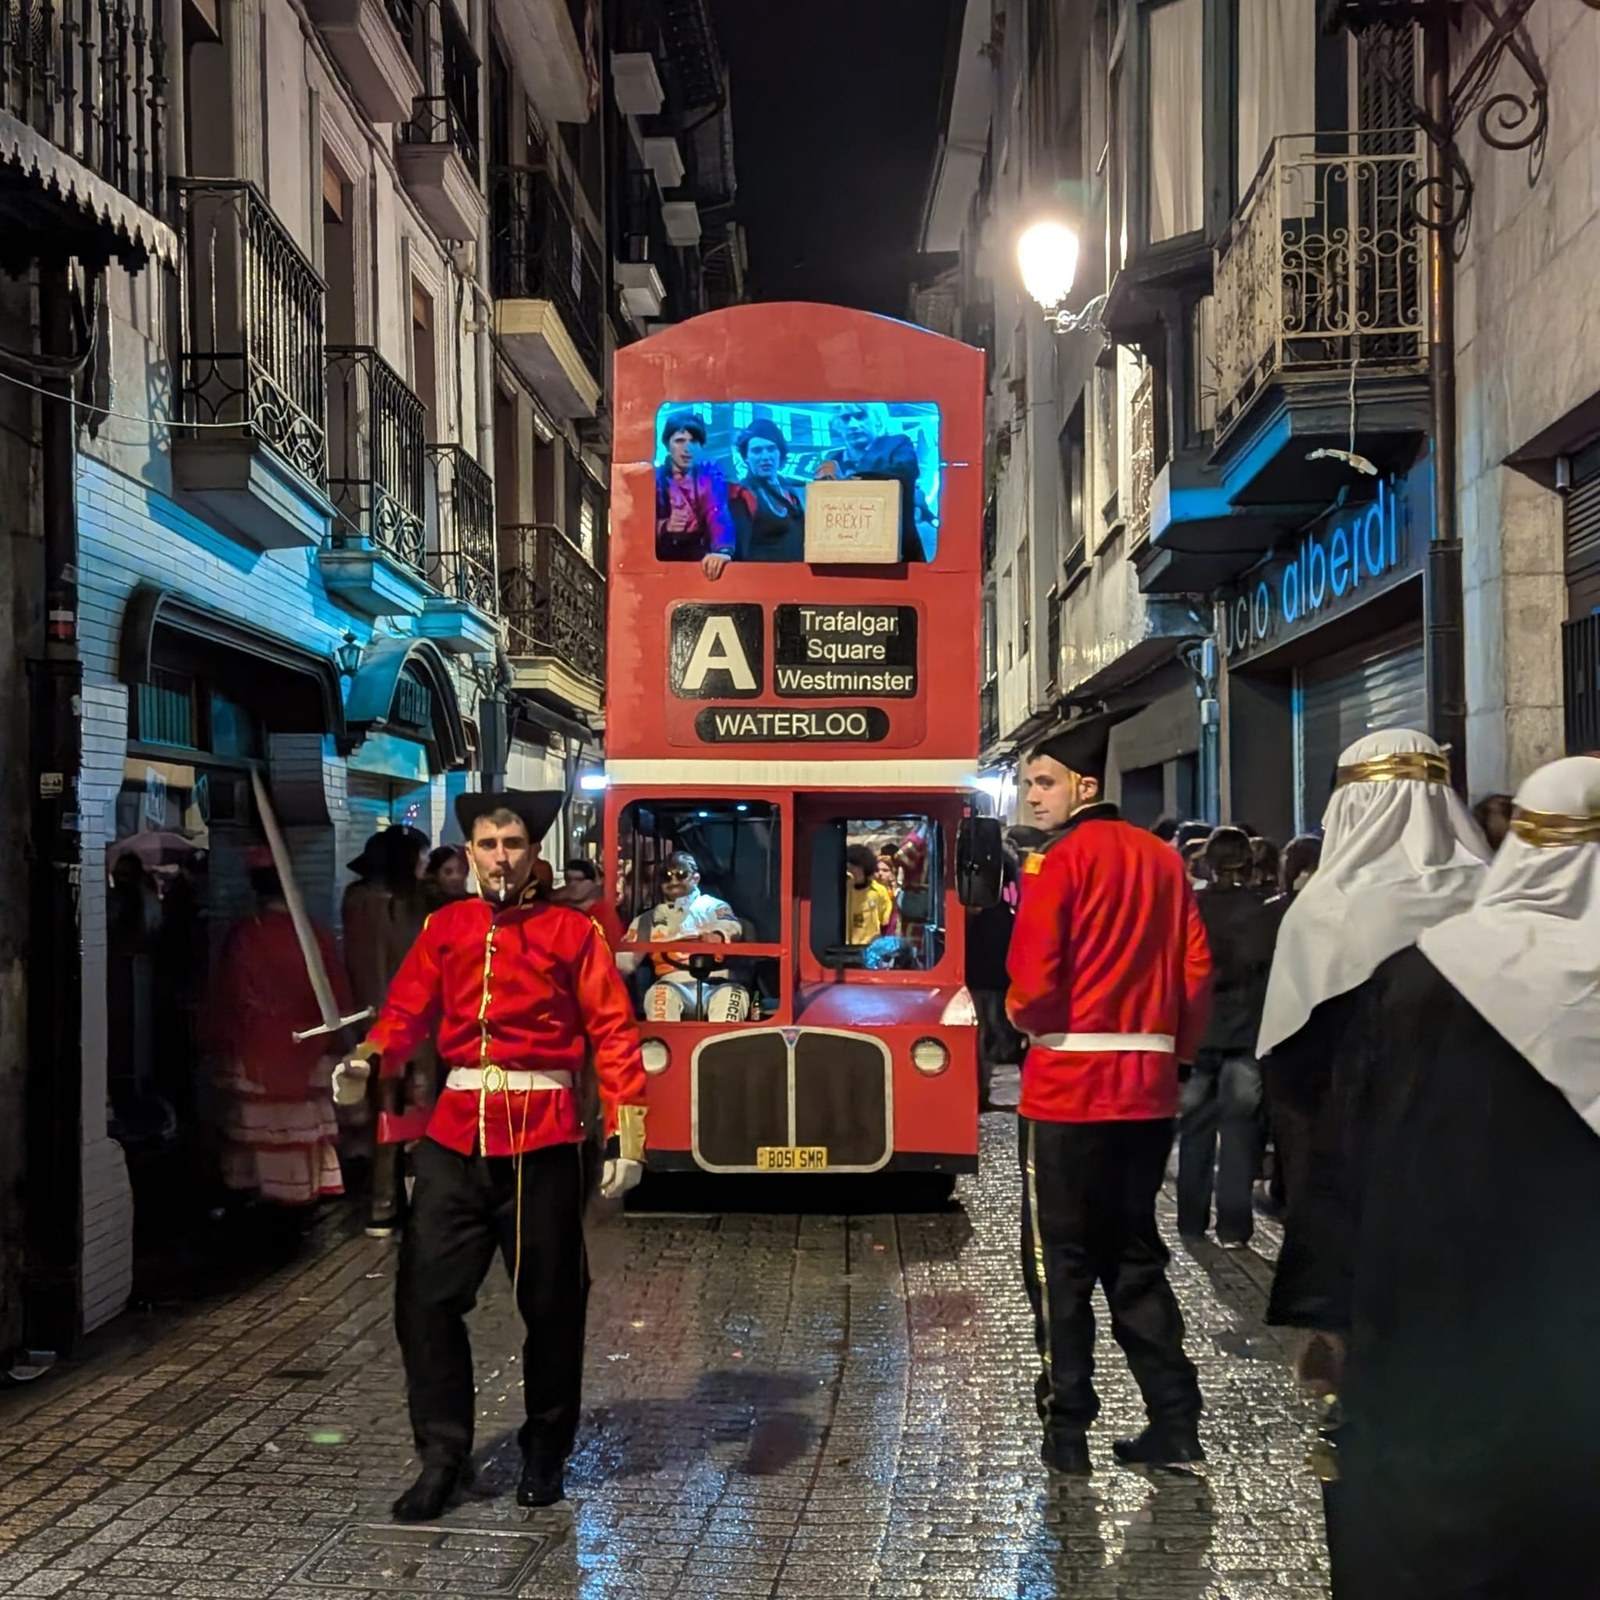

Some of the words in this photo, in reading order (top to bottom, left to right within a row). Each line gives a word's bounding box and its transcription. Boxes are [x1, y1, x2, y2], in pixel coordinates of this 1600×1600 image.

[825, 512, 873, 530] BREXIT
[1282, 472, 1396, 623] alberdi
[800, 610, 898, 636] Trafalgar
[681, 616, 757, 690] A
[807, 639, 886, 663] Square
[777, 669, 914, 691] Westminster
[715, 713, 867, 736] WATERLOO
[799, 1150, 824, 1168] SMR
